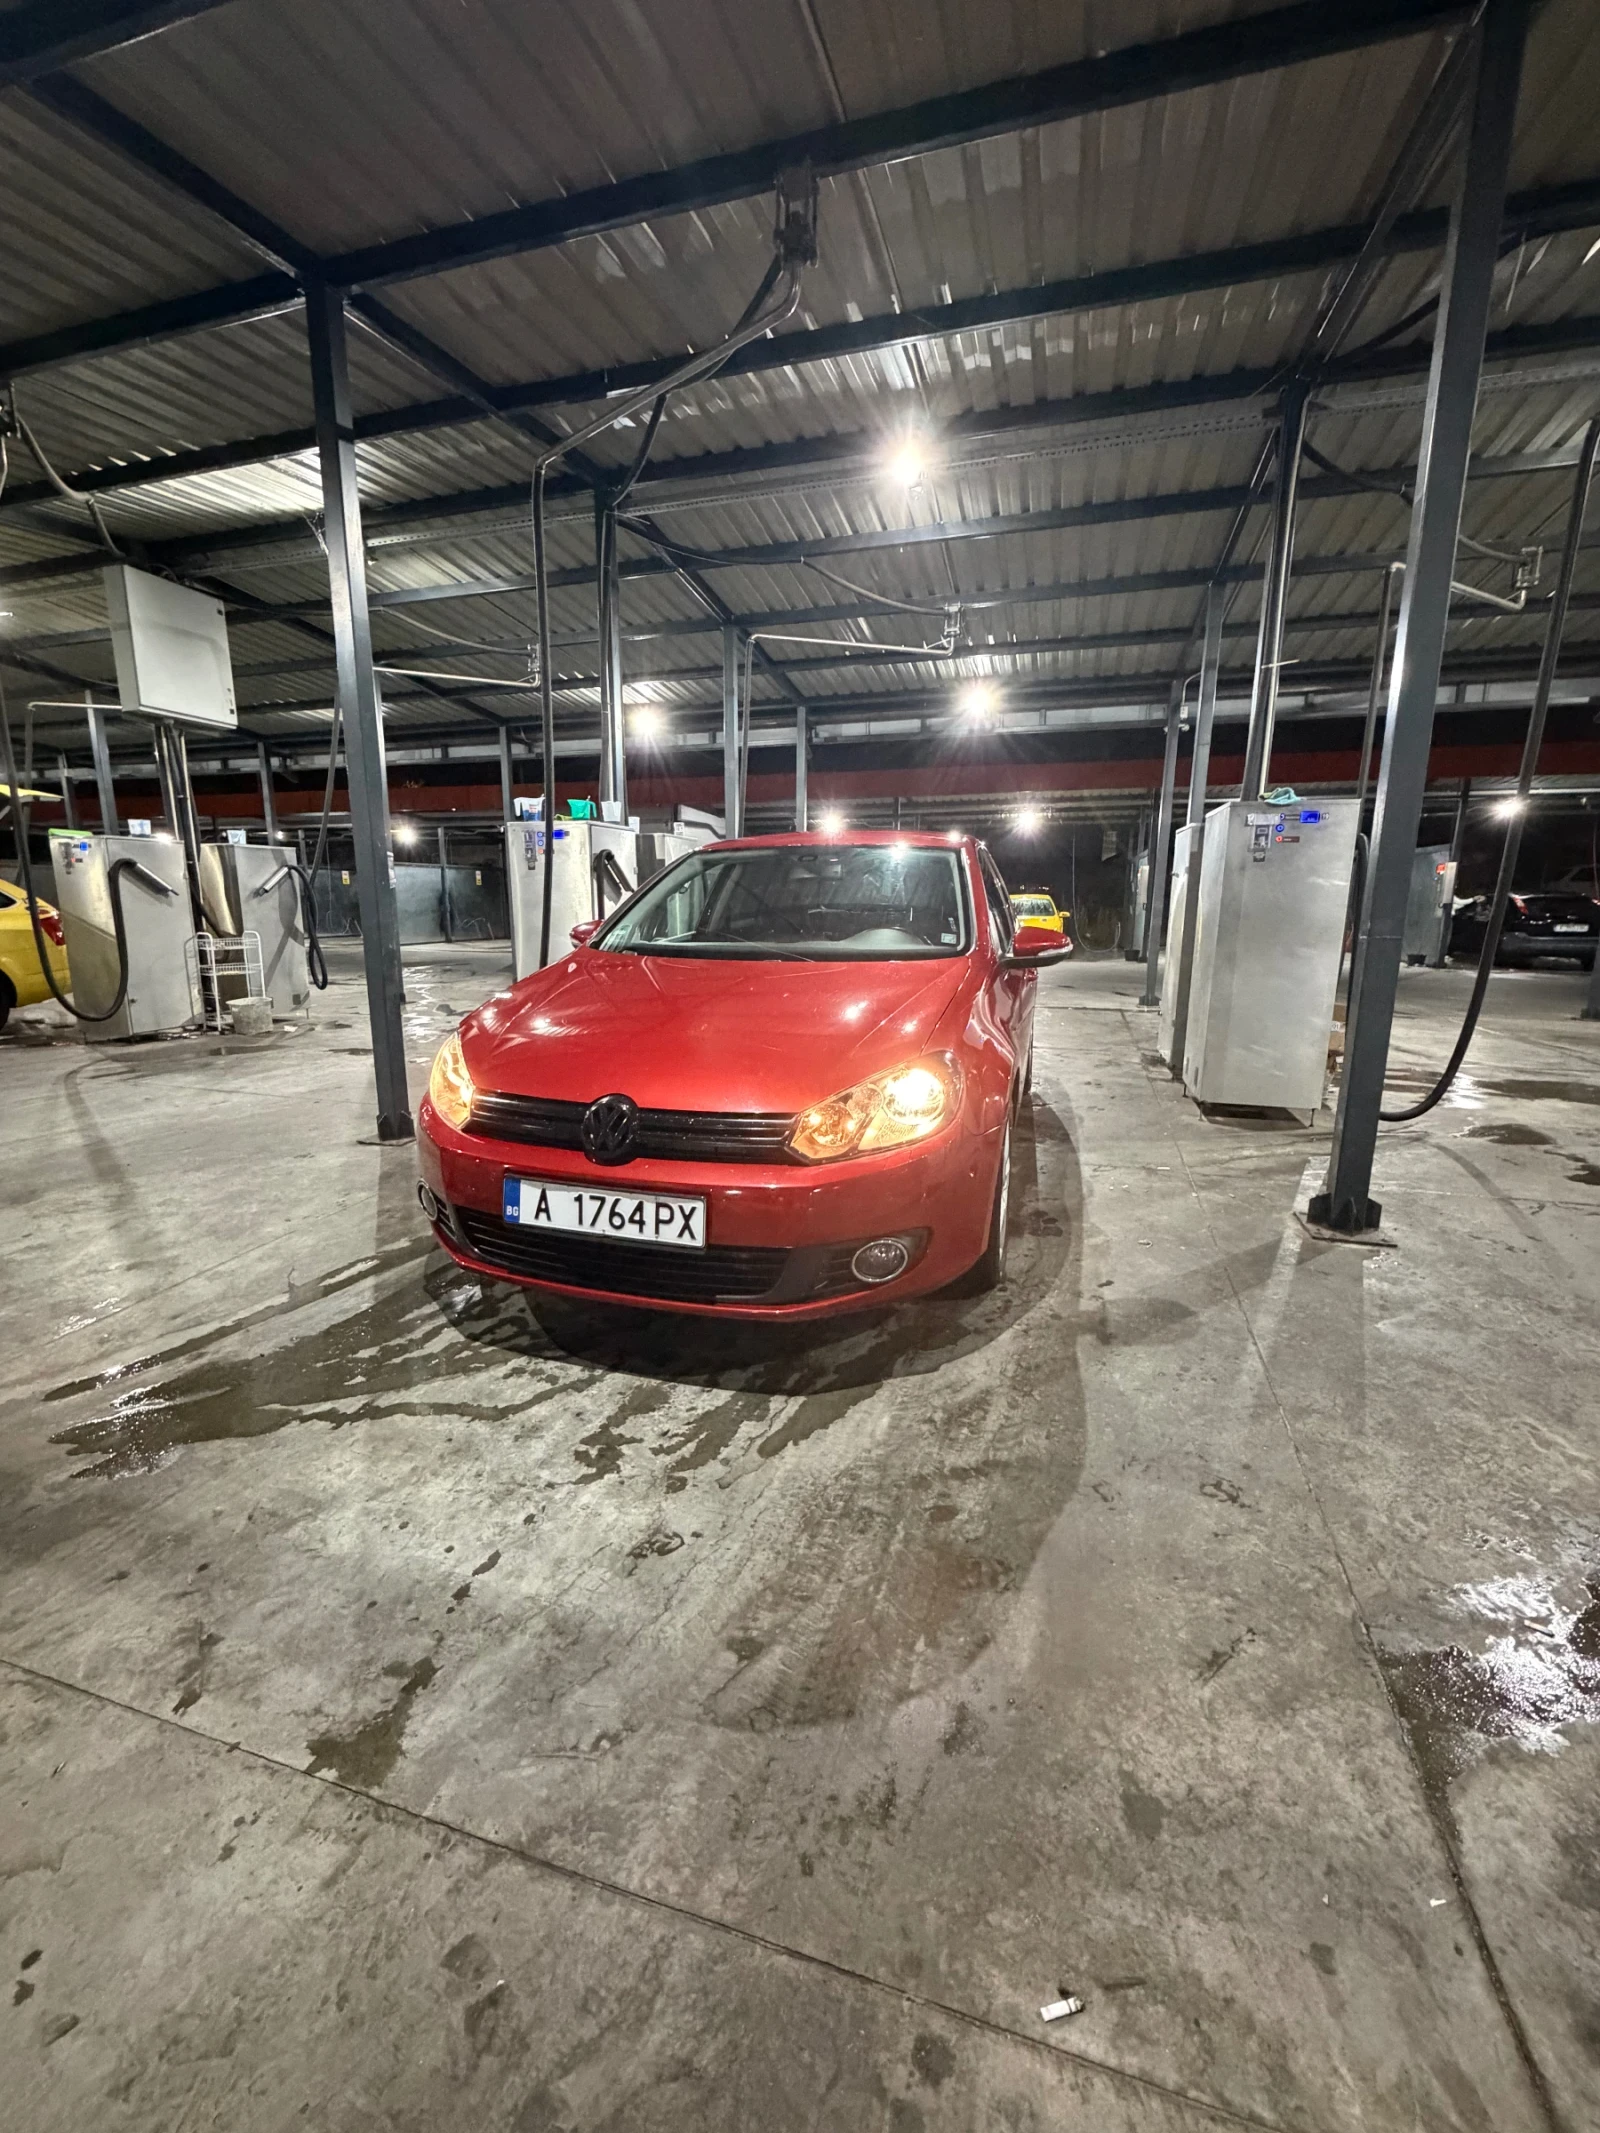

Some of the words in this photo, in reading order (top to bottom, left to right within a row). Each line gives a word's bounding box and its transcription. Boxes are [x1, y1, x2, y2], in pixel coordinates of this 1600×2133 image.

[506, 1205, 519, 1216] BG
[534, 1187, 552, 1222] A
[573, 1193, 646, 1233] 1764
[655, 1202, 697, 1240] PX
